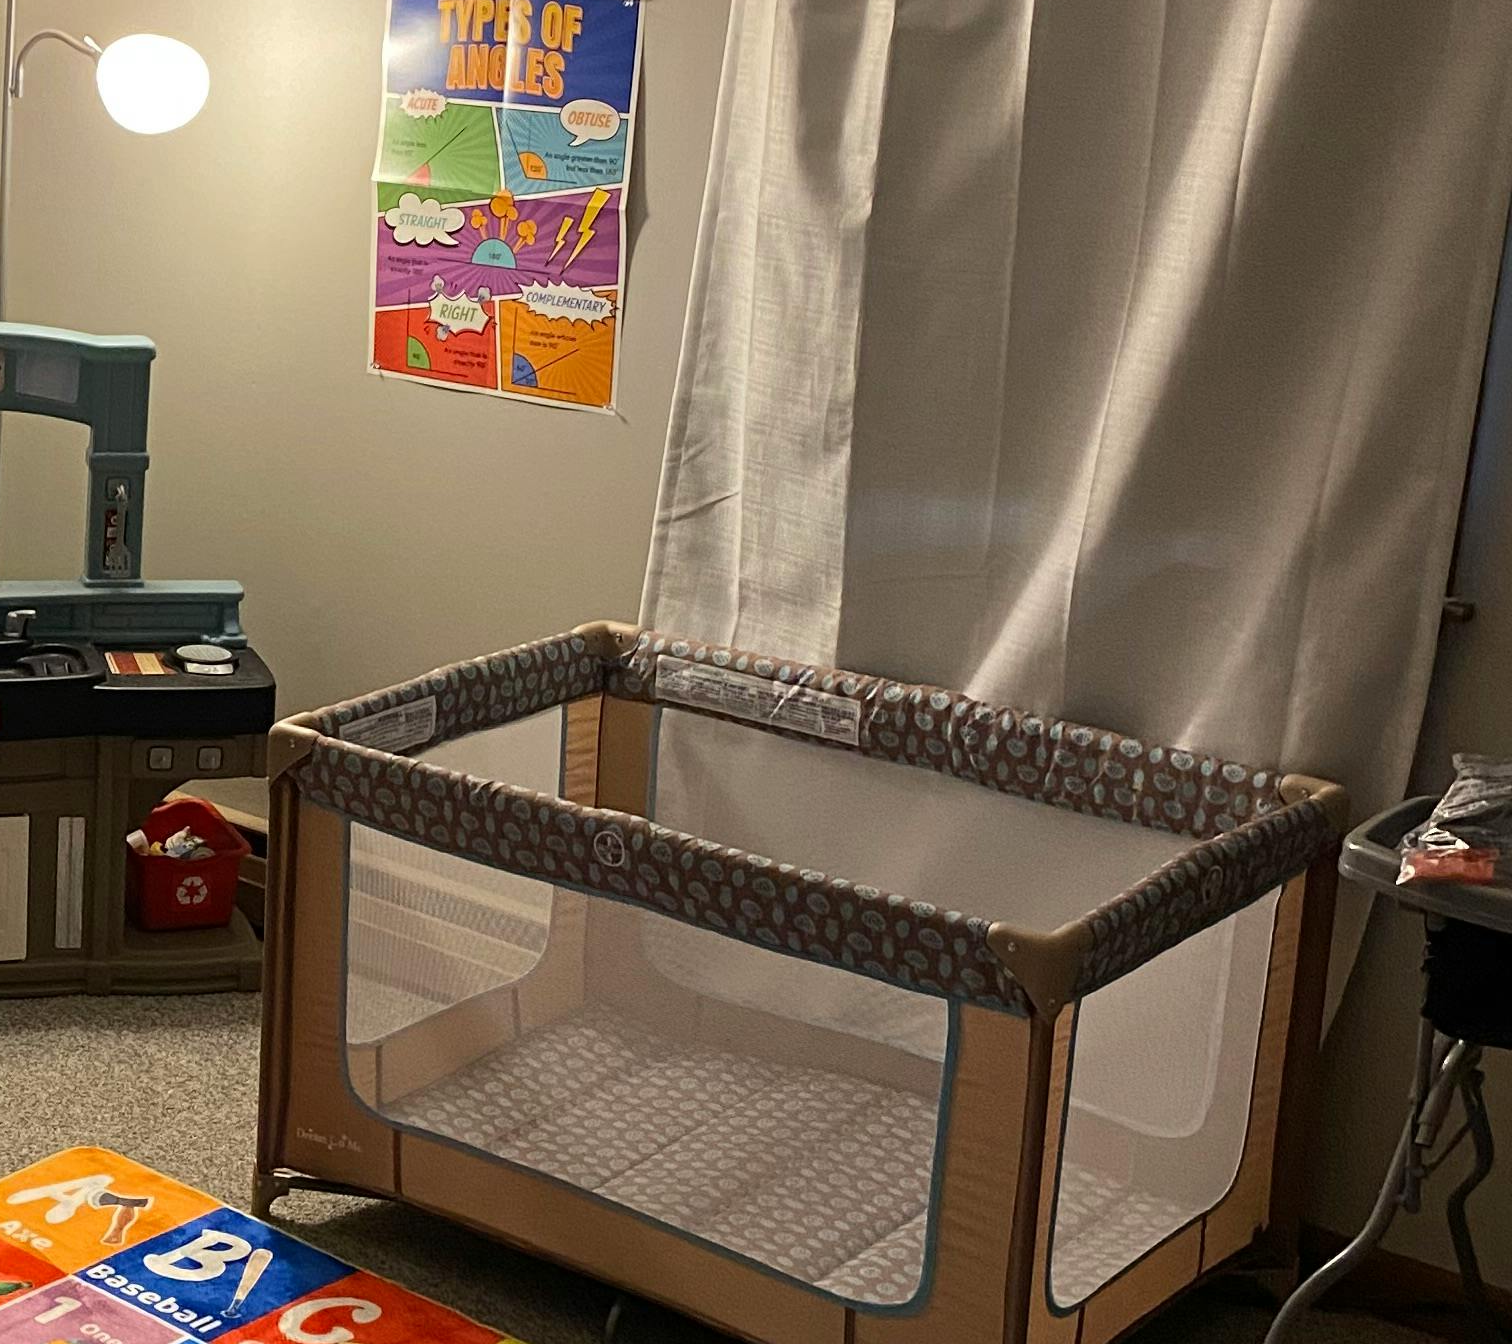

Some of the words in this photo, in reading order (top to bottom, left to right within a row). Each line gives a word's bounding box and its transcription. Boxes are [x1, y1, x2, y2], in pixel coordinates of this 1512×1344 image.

[541, 0, 584, 52] OF
[446, 44, 566, 99] ANGLES
[567, 110, 613, 129] OBTUSE
[399, 213, 447, 228] STRAIGHT
[439, 303, 478, 323] RIGHT
[525, 291, 607, 313] COMPLEMENTARY
[32, 1296, 81, 1325] 1
[87, 1263, 223, 1336] Baseball
